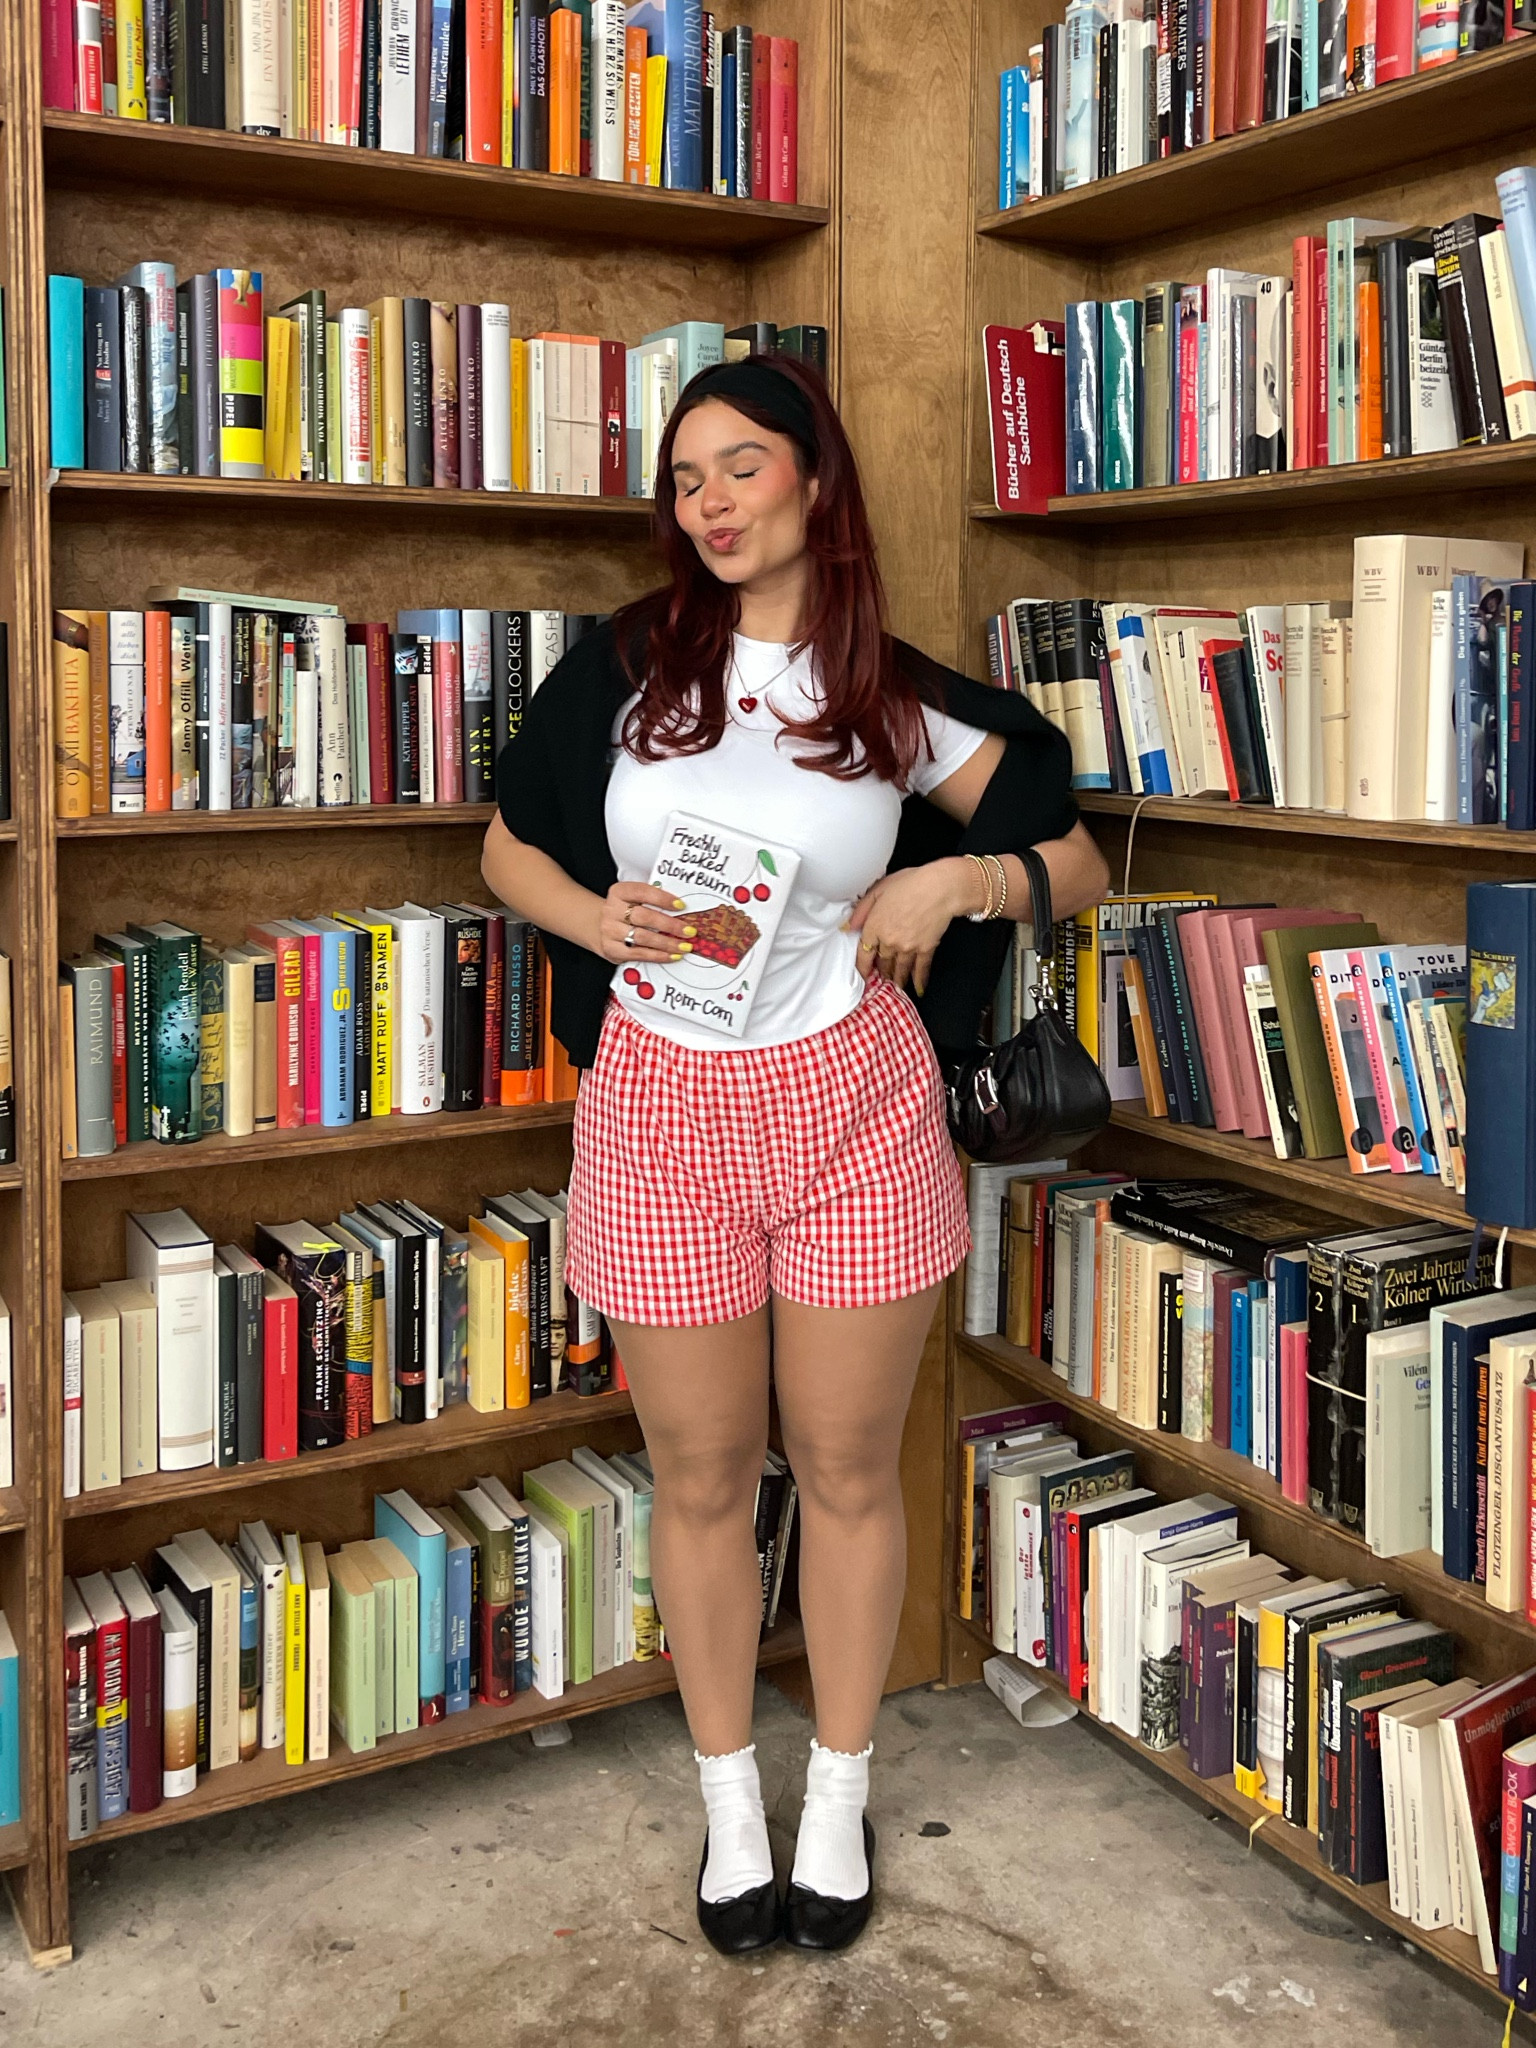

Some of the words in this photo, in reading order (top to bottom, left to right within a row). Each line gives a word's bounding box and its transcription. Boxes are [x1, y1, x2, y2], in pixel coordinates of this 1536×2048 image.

[606, 3, 616, 35] MEIN
[201, 22, 209, 55] LARSSON
[396, 34, 410, 75] LETHEM
[436, 21, 450, 83] Gestrandete
[537, 17, 546, 75] GLASHOTEL
[606, 38, 616, 69] HERZ
[1177, 14, 1187, 70] WALTERS
[606, 71, 616, 88] SO
[683, 0, 702, 138] MATTERHORN
[1196, 45, 1204, 85] WEILER
[537, 77, 546, 97] DAS
[1196, 86, 1204, 107] JAN
[606, 89, 616, 126] WEISS
[315, 304, 323, 355] HEIMKEHR
[412, 341, 421, 385] MUNRO
[996, 339, 1013, 406] Deutsch
[1420, 353, 1443, 364] Berlin
[439, 368, 448, 411] MUNRO
[467, 357, 475, 400] MUNRO
[222, 395, 234, 426] PIPER
[413, 391, 421, 427] ALICE
[1002, 409, 1015, 438] auf
[440, 414, 448, 451] ALICE
[1007, 441, 1020, 500] Bücher
[1363, 567, 1383, 575] WBV
[1417, 564, 1440, 577] WBV
[1457, 591, 1466, 615] gehen
[1262, 629, 1281, 644] Das
[1458, 628, 1466, 644] Lust
[1459, 616, 1465, 627] zu
[180, 629, 191, 672] Wetter
[423, 645, 431, 673] PIPER
[467, 644, 480, 670] THE
[508, 616, 522, 711] CLOCKERS
[1458, 645, 1466, 659] Die
[64, 657, 80, 735] BAKHITA
[181, 680, 192, 713] Offill
[218, 673, 227, 701] trinken
[445, 671, 453, 688] pro
[218, 701, 228, 726] Kaffee
[402, 700, 410, 735] PEPPER
[444, 688, 453, 718] Meter
[181, 718, 193, 755] Jenny
[326, 732, 336, 754] Ann
[335, 722, 345, 760] Patchett
[402, 735, 411, 763] KATE
[445, 735, 453, 760] Stine
[469, 729, 480, 767] ANN
[483, 714, 492, 780] PETRY
[64, 739, 80, 787] OLMI
[94, 738, 103, 792] STEWART
[669, 826, 723, 859] Freshly
[678, 849, 731, 876] Baked
[376, 932, 387, 980] NAMEN
[422, 930, 430, 951] Verse
[1065, 920, 1076, 984] STUNDEN
[178, 952, 189, 992] Rendell
[188, 943, 198, 979] Wasser
[283, 950, 301, 997] GILEAD
[423, 952, 431, 996] satanischen
[512, 943, 521, 988] RUSSO
[1417, 954, 1456, 966] TOVE
[179, 995, 189, 1021] Ruth
[189, 980, 198, 1020] Dunkle
[423, 996, 431, 1012] Die
[486, 979, 496, 1011] LUKA
[661, 984, 735, 1027] Rom-Com
[1174, 999, 1184, 1016] Die
[89, 978, 104, 1065] RAIMUND
[288, 1004, 298, 1042] ROBINSON
[355, 1002, 363, 1026] ROSS
[376, 1002, 387, 1037] RUFF
[485, 1013, 493, 1049] SALMAN
[510, 993, 521, 1052] RICHARD
[376, 1041, 388, 1076] MATT
[525, 1031, 534, 1060] DIESE
[1159, 1039, 1170, 1069] Corbin
[288, 1042, 299, 1087] MARILYNNE
[417, 1044, 427, 1087] SALMAN
[427, 1041, 435, 1086] RUSHDIE
[339, 1065, 347, 1102] ABRAHAM
[1101, 1231, 1110, 1297] EMMERICH
[1122, 1246, 1132, 1305] EMMERICH
[1383, 1265, 1418, 1290] Zwei
[530, 1264, 538, 1310] Shakespeare
[540, 1255, 549, 1326] ERBSCHAFT
[1315, 1291, 1324, 1312] 2
[1384, 1285, 1432, 1310] Kölner
[587, 1320, 596, 1338] SAM
[1351, 1303, 1357, 1323] 1
[315, 1300, 324, 1362] SCHÄTZING
[540, 1328, 549, 1350] DIE
[1101, 1302, 1110, 1364] KATHARINA
[1121, 1309, 1132, 1375] KATHARINA
[65, 1363, 73, 1395] KAFFEE
[223, 1381, 231, 1411] SCHLAG
[315, 1364, 324, 1401] FRANK
[1101, 1365, 1109, 1397] ANNA
[1477, 1367, 1487, 1401] Haaren
[1121, 1380, 1132, 1414] ANNA
[1477, 1401, 1487, 1426] roten
[223, 1411, 231, 1439] EVELYN
[1476, 1426, 1487, 1442] mit
[1476, 1442, 1487, 1467] Kind
[513, 1524, 529, 1586] PUNKTE
[1475, 1538, 1485, 1582] Elisabeth
[265, 1633, 273, 1664] Steiner
[514, 1605, 529, 1663] WUNDE
[104, 1659, 122, 1714] LONDON
[265, 1665, 273, 1686] Jens
[1286, 1664, 1295, 1683] den
[1286, 1685, 1294, 1699] bei
[1328, 1678, 1342, 1752] Überwachung
[1285, 1735, 1294, 1752] Der
[104, 1759, 122, 1802] ZADIE
[1504, 1770, 1520, 1808] BOOK
[1504, 1810, 1519, 1868] COMFORT
[1504, 1872, 1518, 1896] THE
